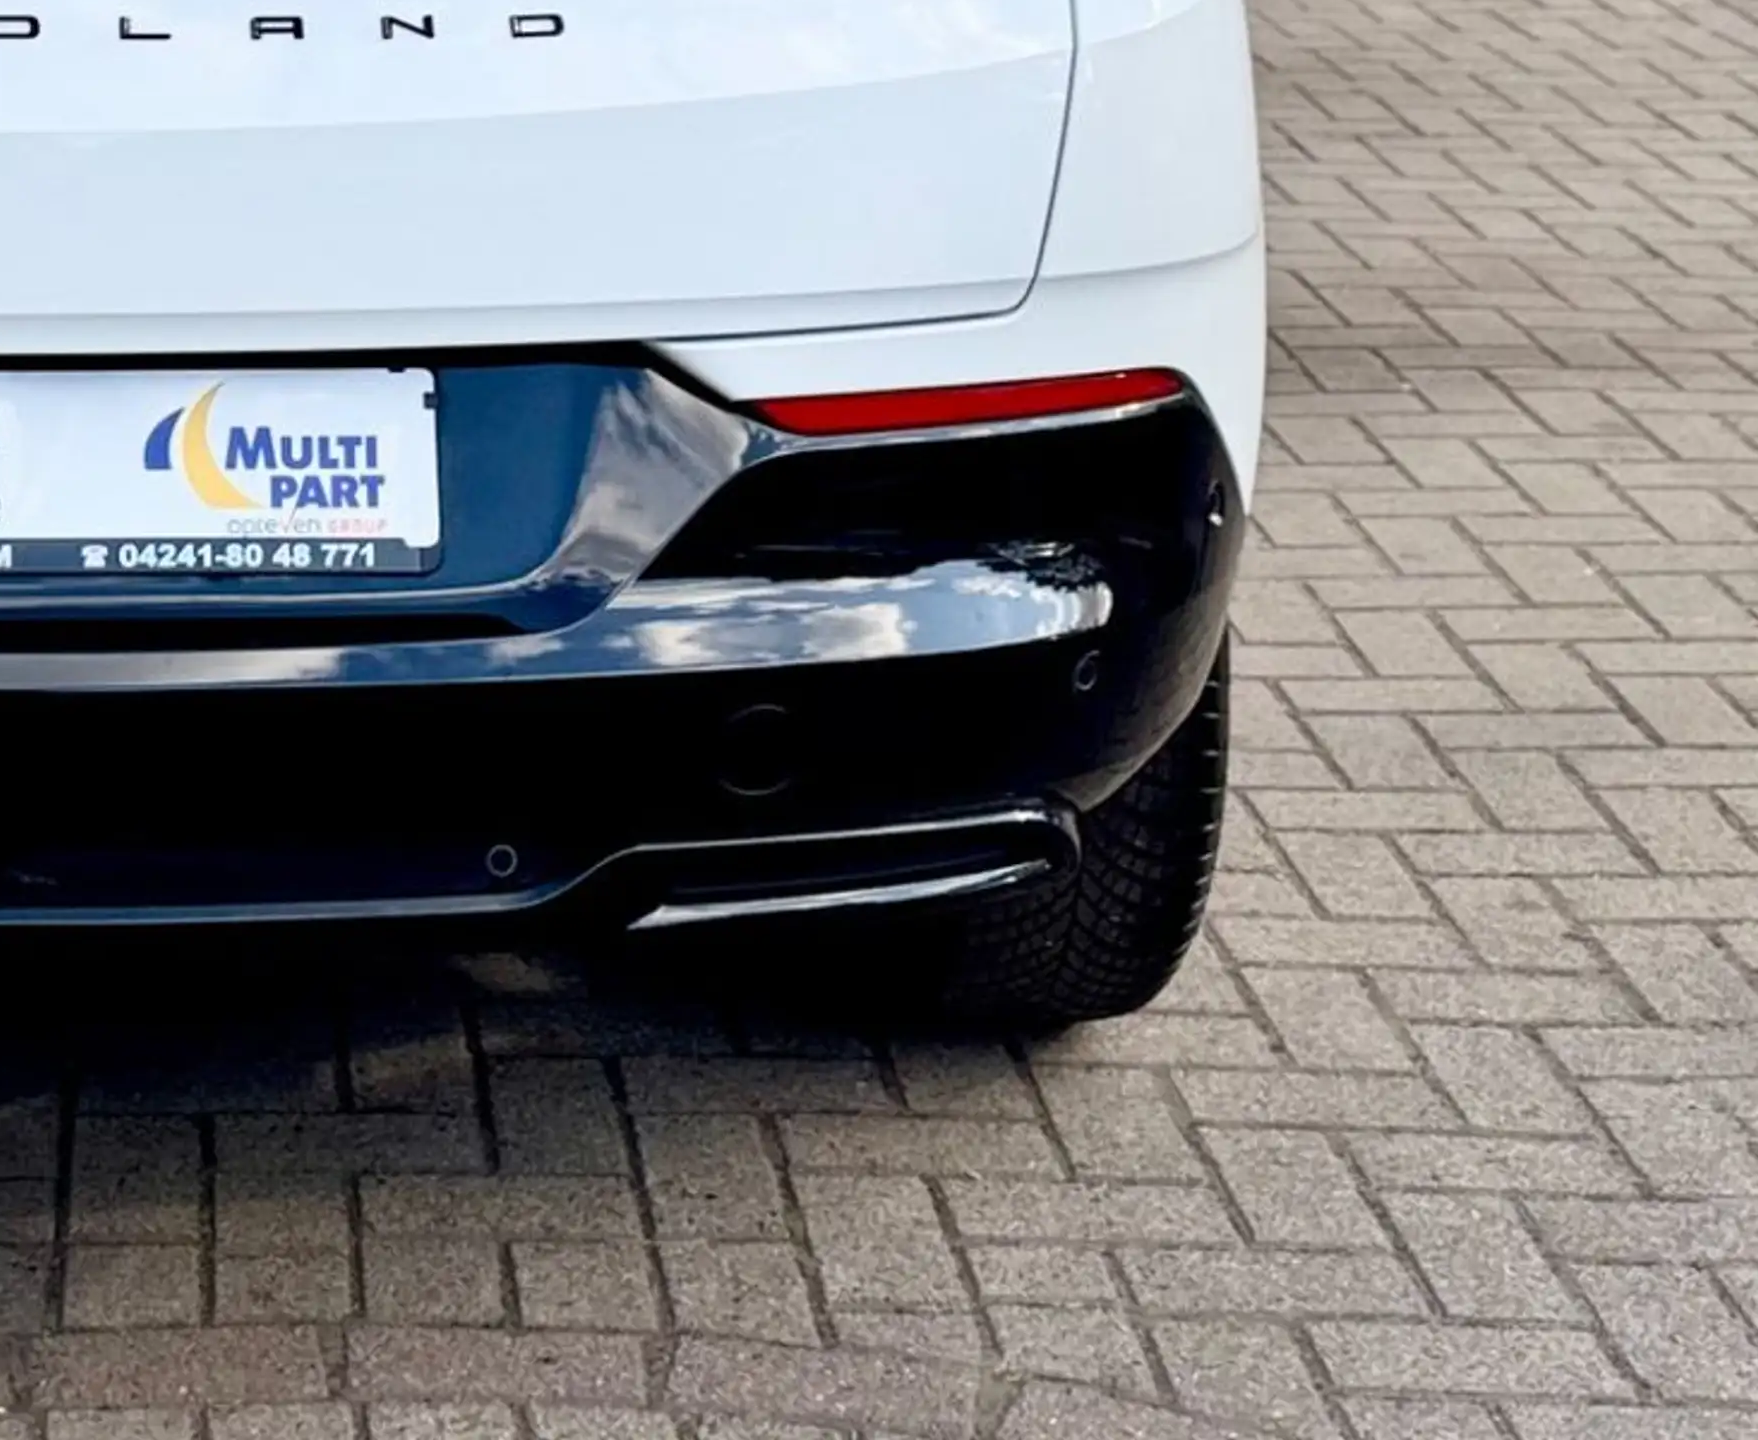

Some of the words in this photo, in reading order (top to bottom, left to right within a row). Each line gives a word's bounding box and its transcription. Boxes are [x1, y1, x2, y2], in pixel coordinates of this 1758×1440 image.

[225, 426, 378, 470] MULTI
[269, 475, 385, 509] PART
[118, 542, 263, 568] 04241-80
[272, 542, 312, 568] 48
[320, 542, 375, 567] 771
